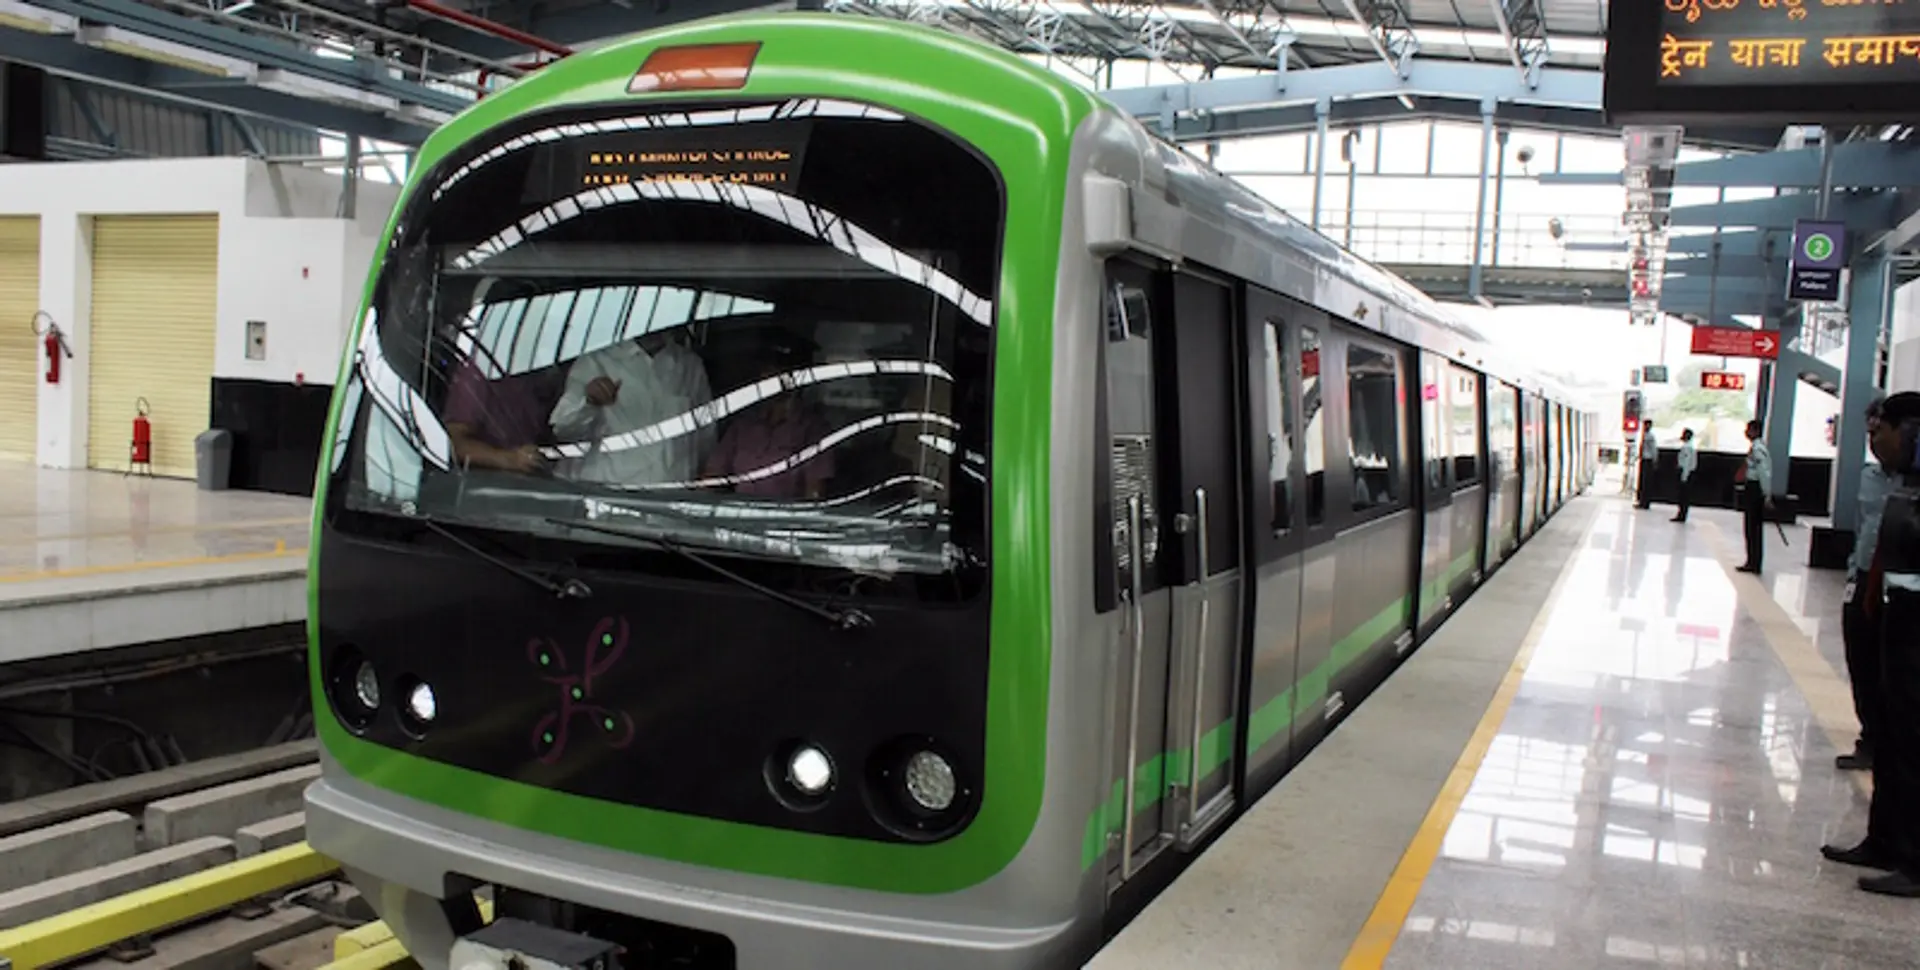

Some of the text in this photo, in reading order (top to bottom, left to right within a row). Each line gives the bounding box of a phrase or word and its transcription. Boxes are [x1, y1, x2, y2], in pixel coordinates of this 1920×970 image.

[1660, 33, 1920, 77] ट्रेन यात्रा समाप्
[1813, 240, 1825, 256] 2
